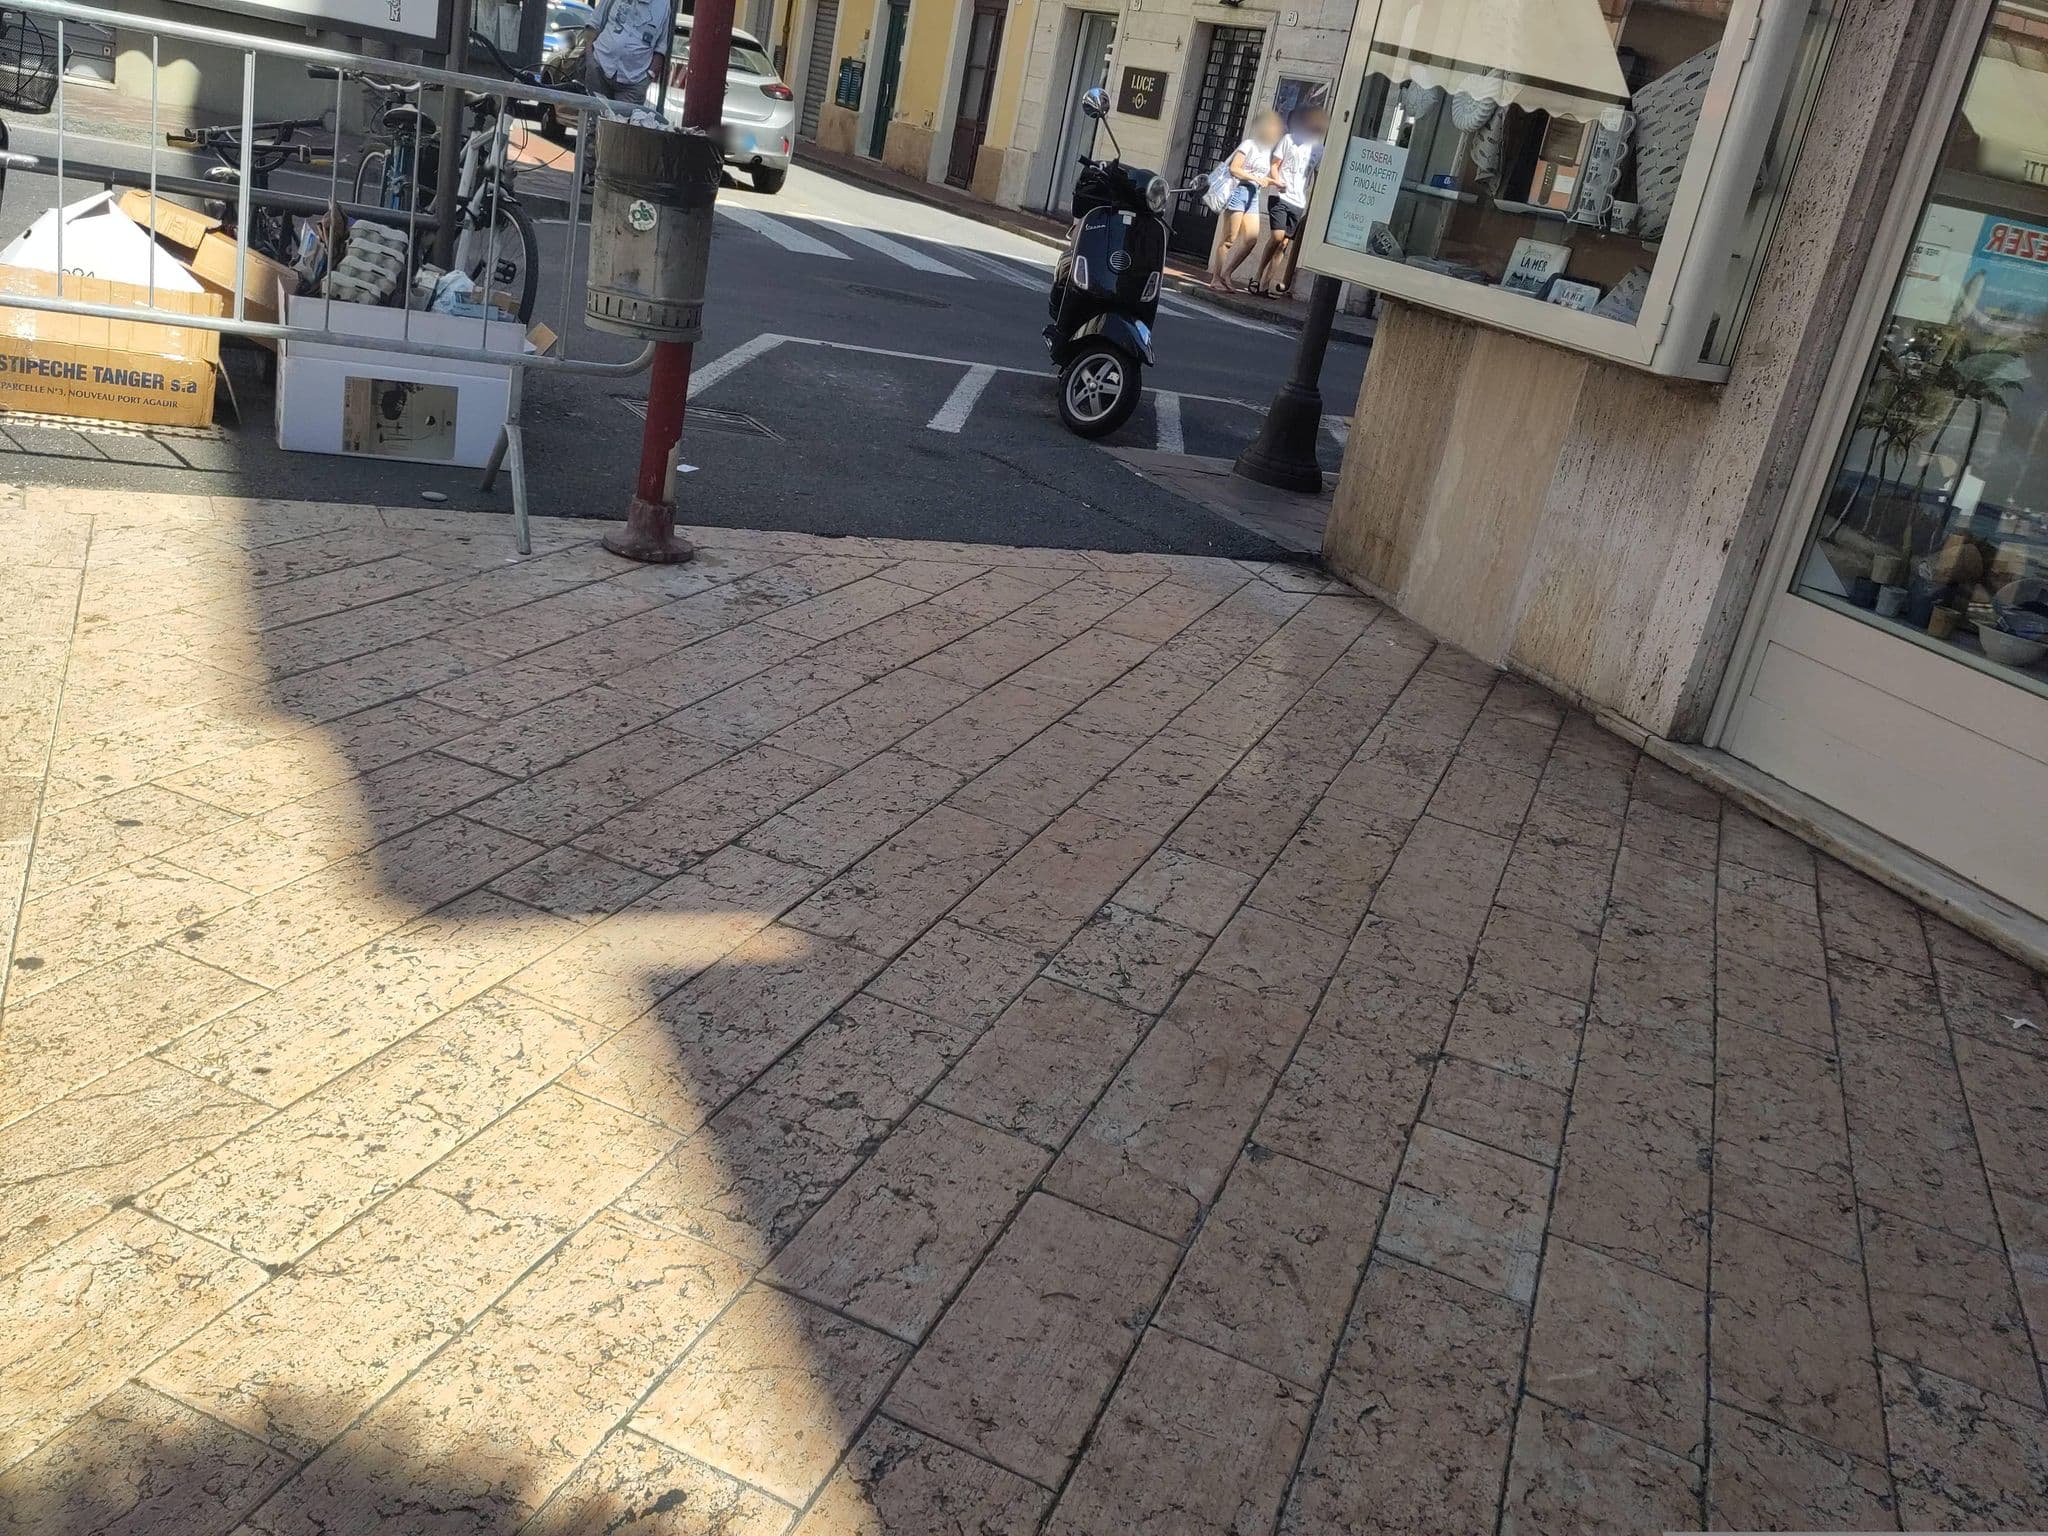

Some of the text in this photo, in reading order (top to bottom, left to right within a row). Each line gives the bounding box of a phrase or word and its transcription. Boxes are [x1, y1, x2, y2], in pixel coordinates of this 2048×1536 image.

[1131, 75, 1155, 92] LUCE
[1361, 148, 1393, 166] STASERA
[1349, 161, 1398, 182] SIAMO APERTI
[1369, 180, 1388, 195] ALLE
[1520, 256, 1548, 272] LA MER
[92, 365, 165, 391] TANGER
[1, 381, 44, 394] PARCELLE
[68, 389, 115, 402] NOUVEAU
[117, 395, 142, 404] PORT
[143, 397, 178, 408] AGADIR
